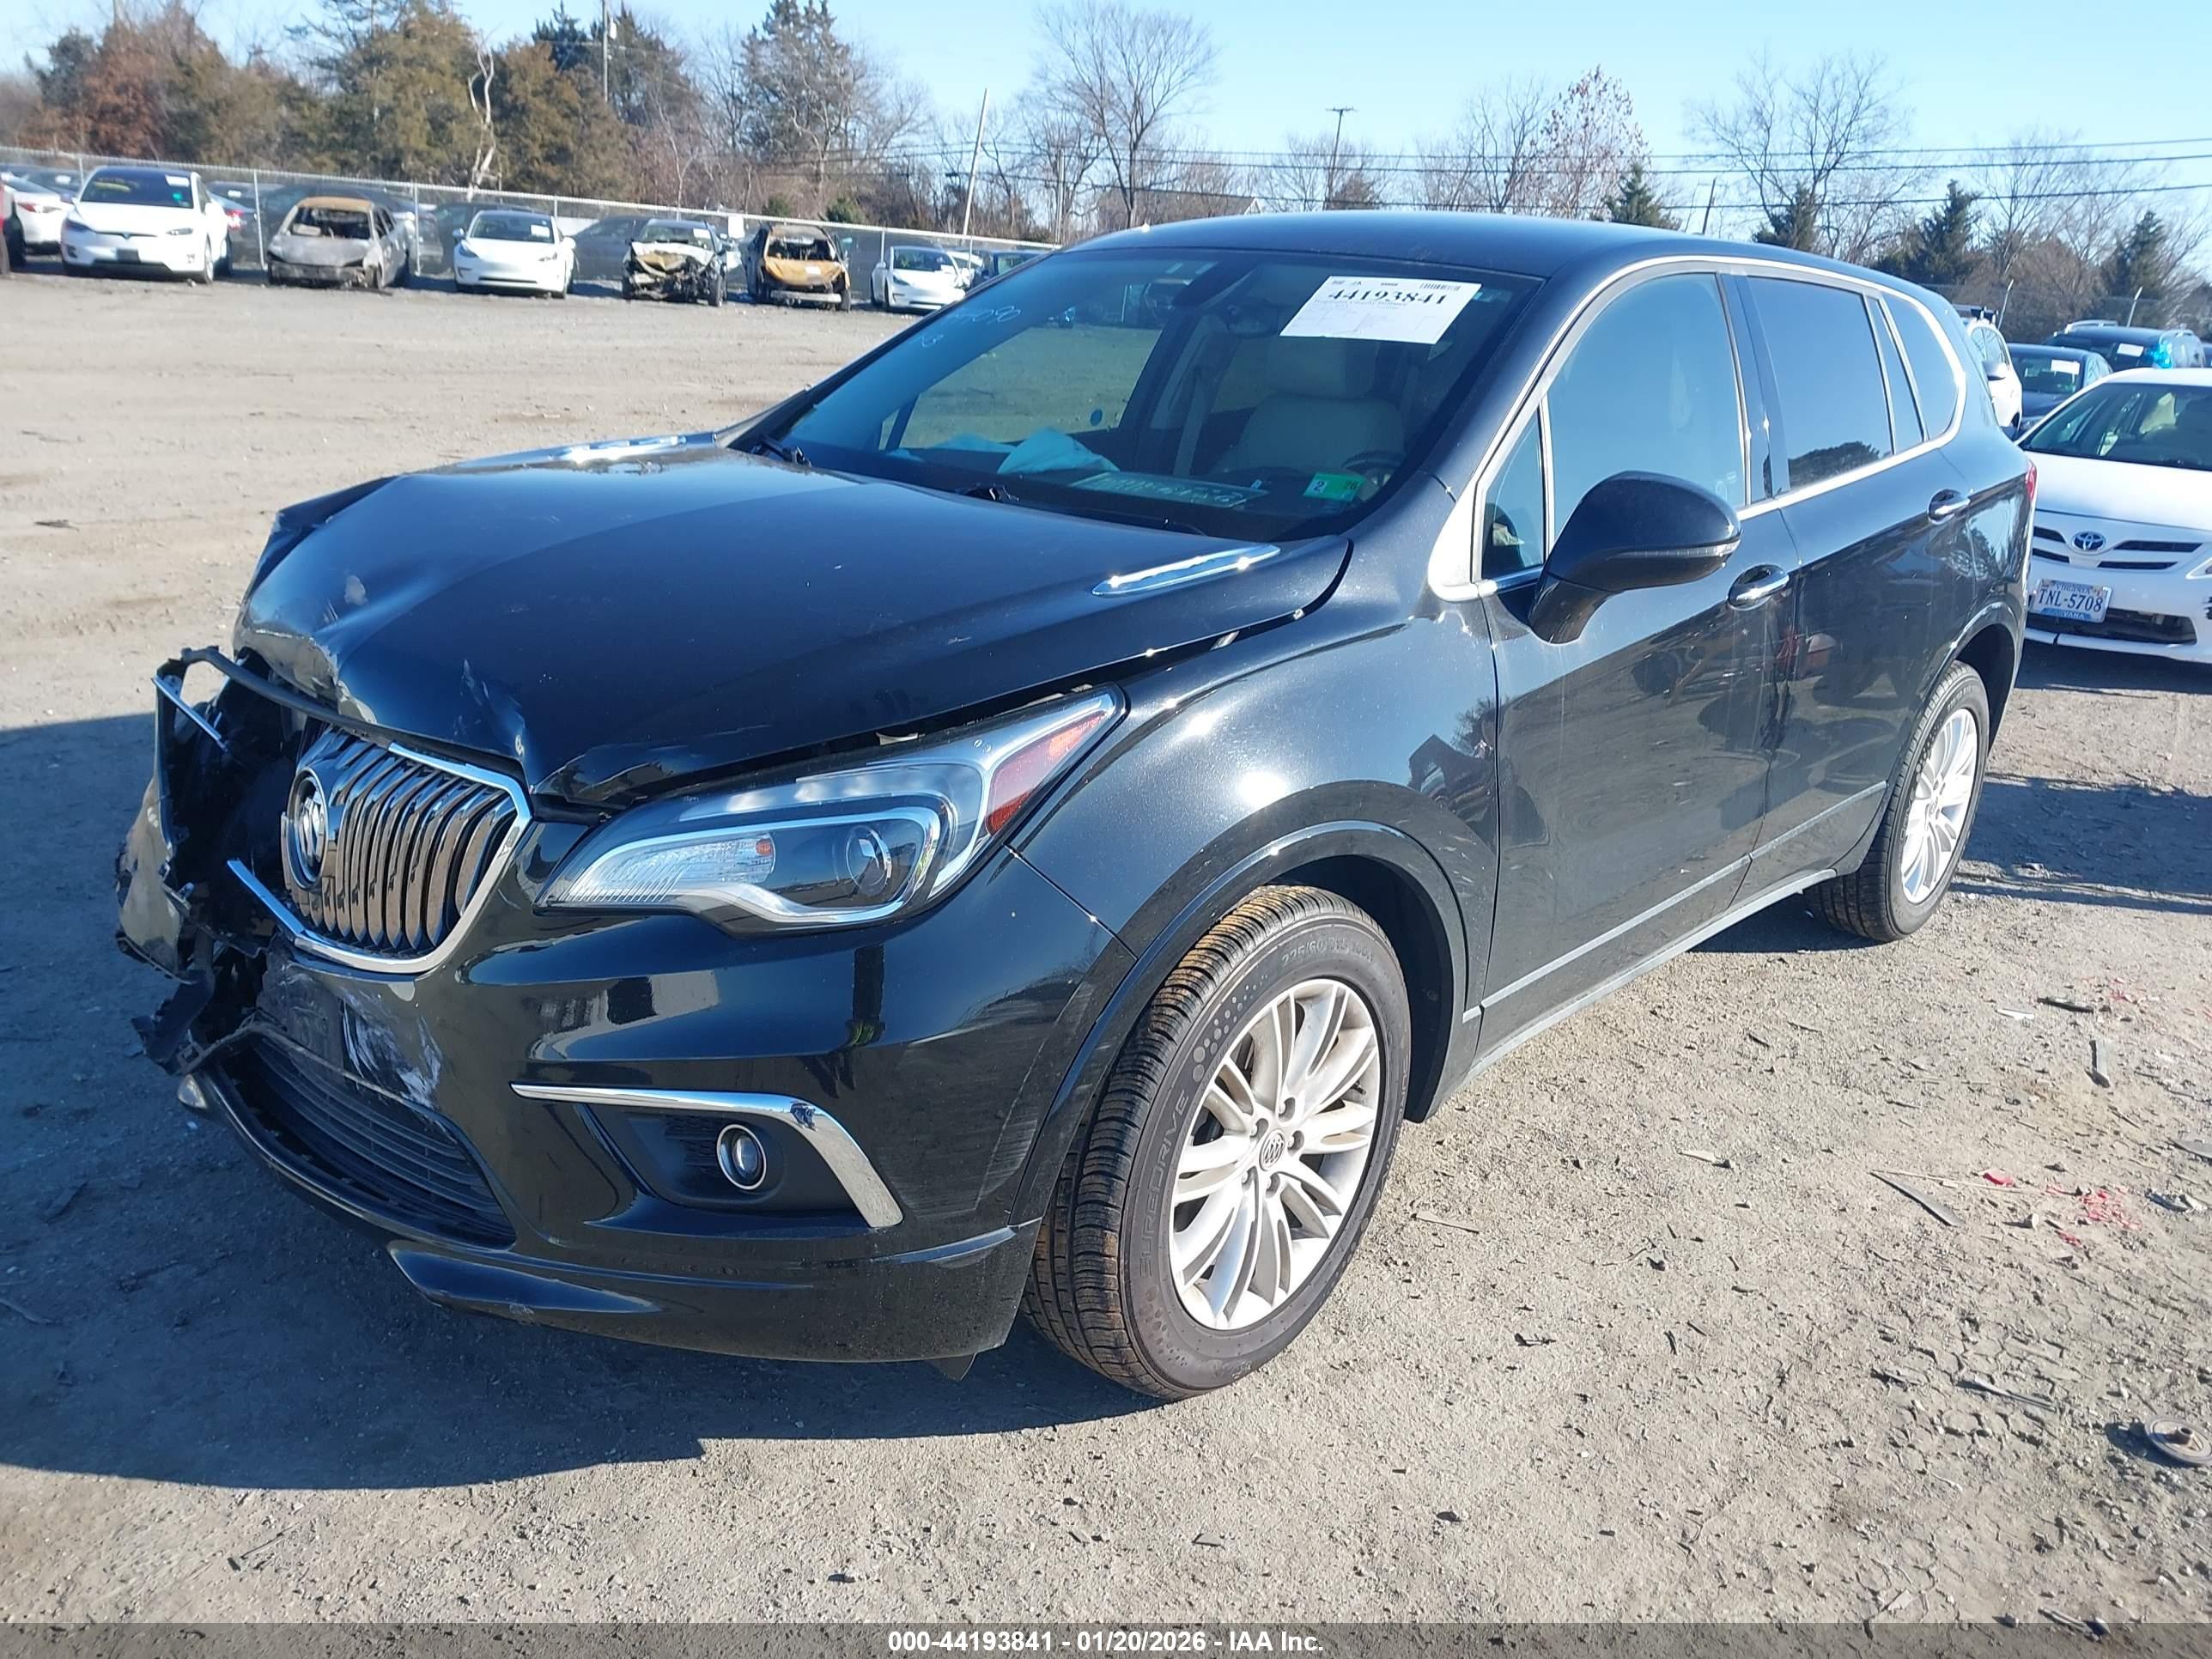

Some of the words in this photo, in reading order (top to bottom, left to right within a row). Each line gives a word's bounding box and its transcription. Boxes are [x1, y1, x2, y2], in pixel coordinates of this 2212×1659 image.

[1328, 289, 1448, 305] 44193841
[2056, 582, 2090, 594] VIRGINIA
[2039, 588, 2103, 612] TNL-5708
